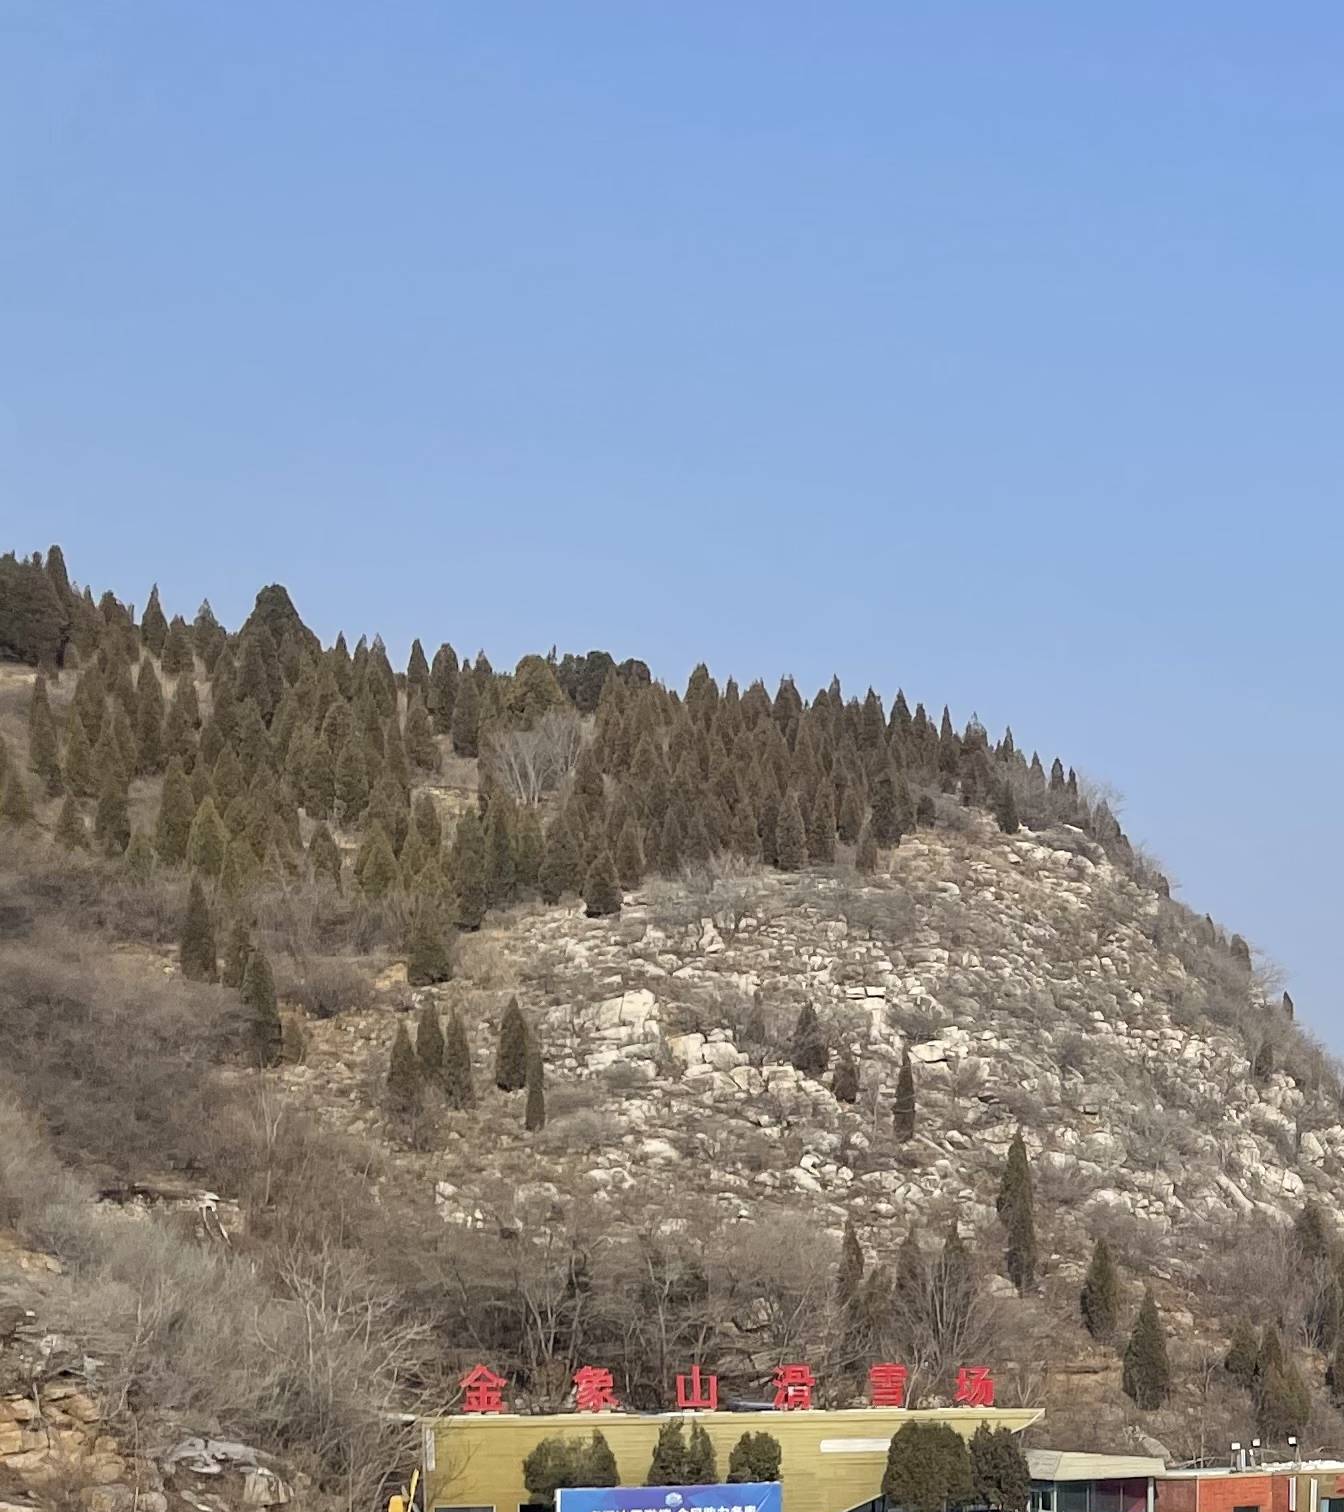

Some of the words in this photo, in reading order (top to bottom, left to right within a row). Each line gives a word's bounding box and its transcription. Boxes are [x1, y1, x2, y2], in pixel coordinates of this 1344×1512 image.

[459, 1364, 995, 1412] 金象山滑雪场
